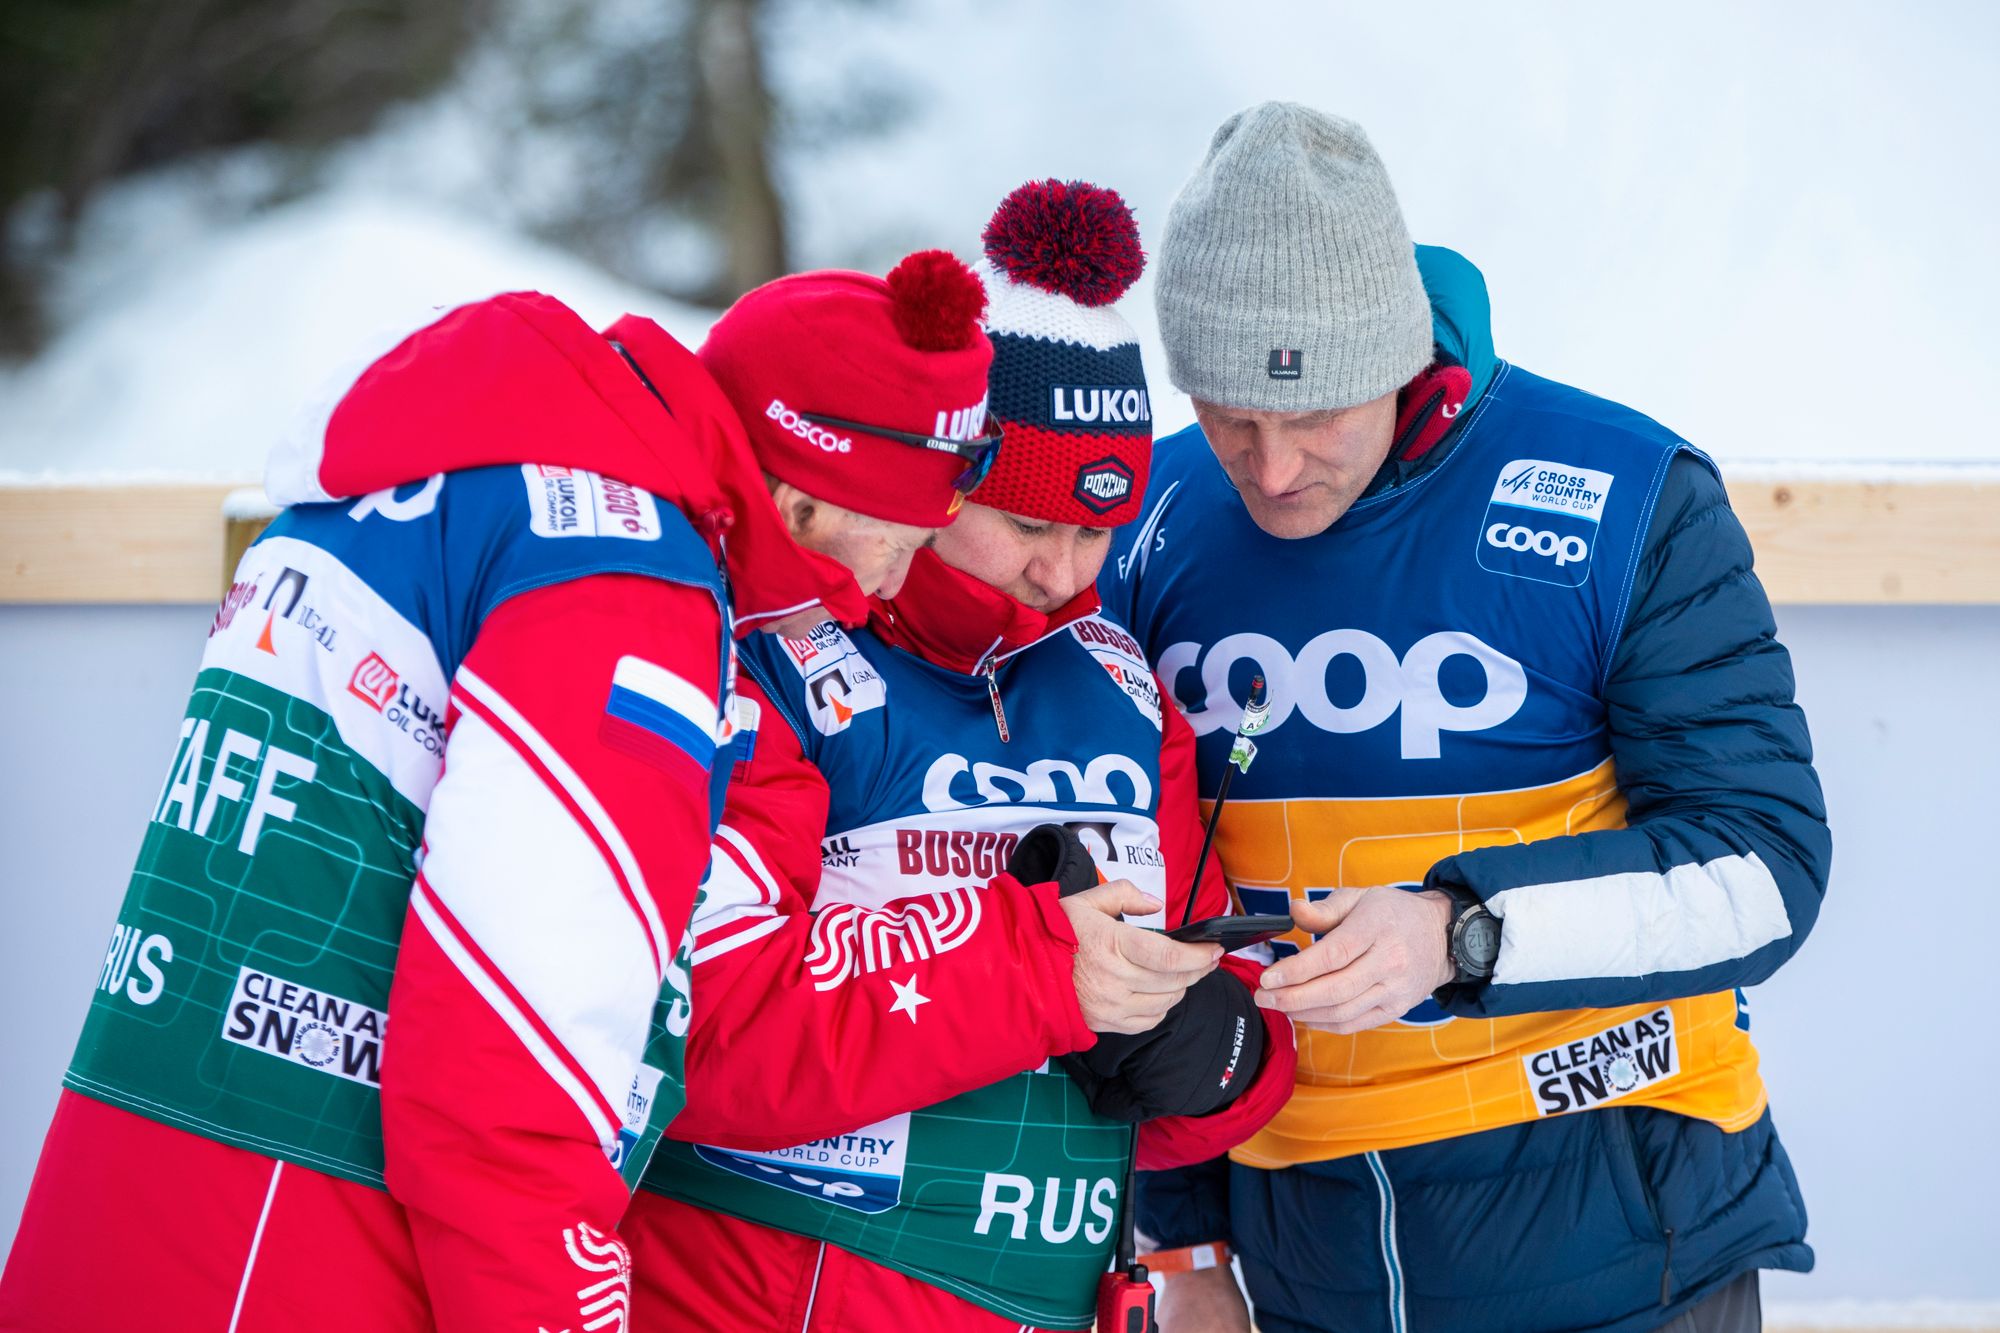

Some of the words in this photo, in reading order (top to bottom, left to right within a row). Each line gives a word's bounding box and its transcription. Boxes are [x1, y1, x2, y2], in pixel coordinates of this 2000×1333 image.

[1532, 494, 1568, 506] WORLD
[1572, 501, 1594, 511] CUP
[1534, 483, 1602, 504] COUNTRY
[1538, 471, 1586, 488] CROSS
[557, 478, 578, 531] LUKOIL
[1486, 523, 1588, 567] coop
[1156, 628, 1528, 760] coop
[387, 708, 410, 733] OIL
[96, 923, 174, 1006] RUS
[243, 973, 350, 1028] CLEAN
[352, 1010, 388, 1041] A
[1531, 1026, 1631, 1077] CLEAN
[1634, 1010, 1671, 1044] AS
[840, 1154, 880, 1168] CUP
[973, 1172, 1117, 1244] RUS
